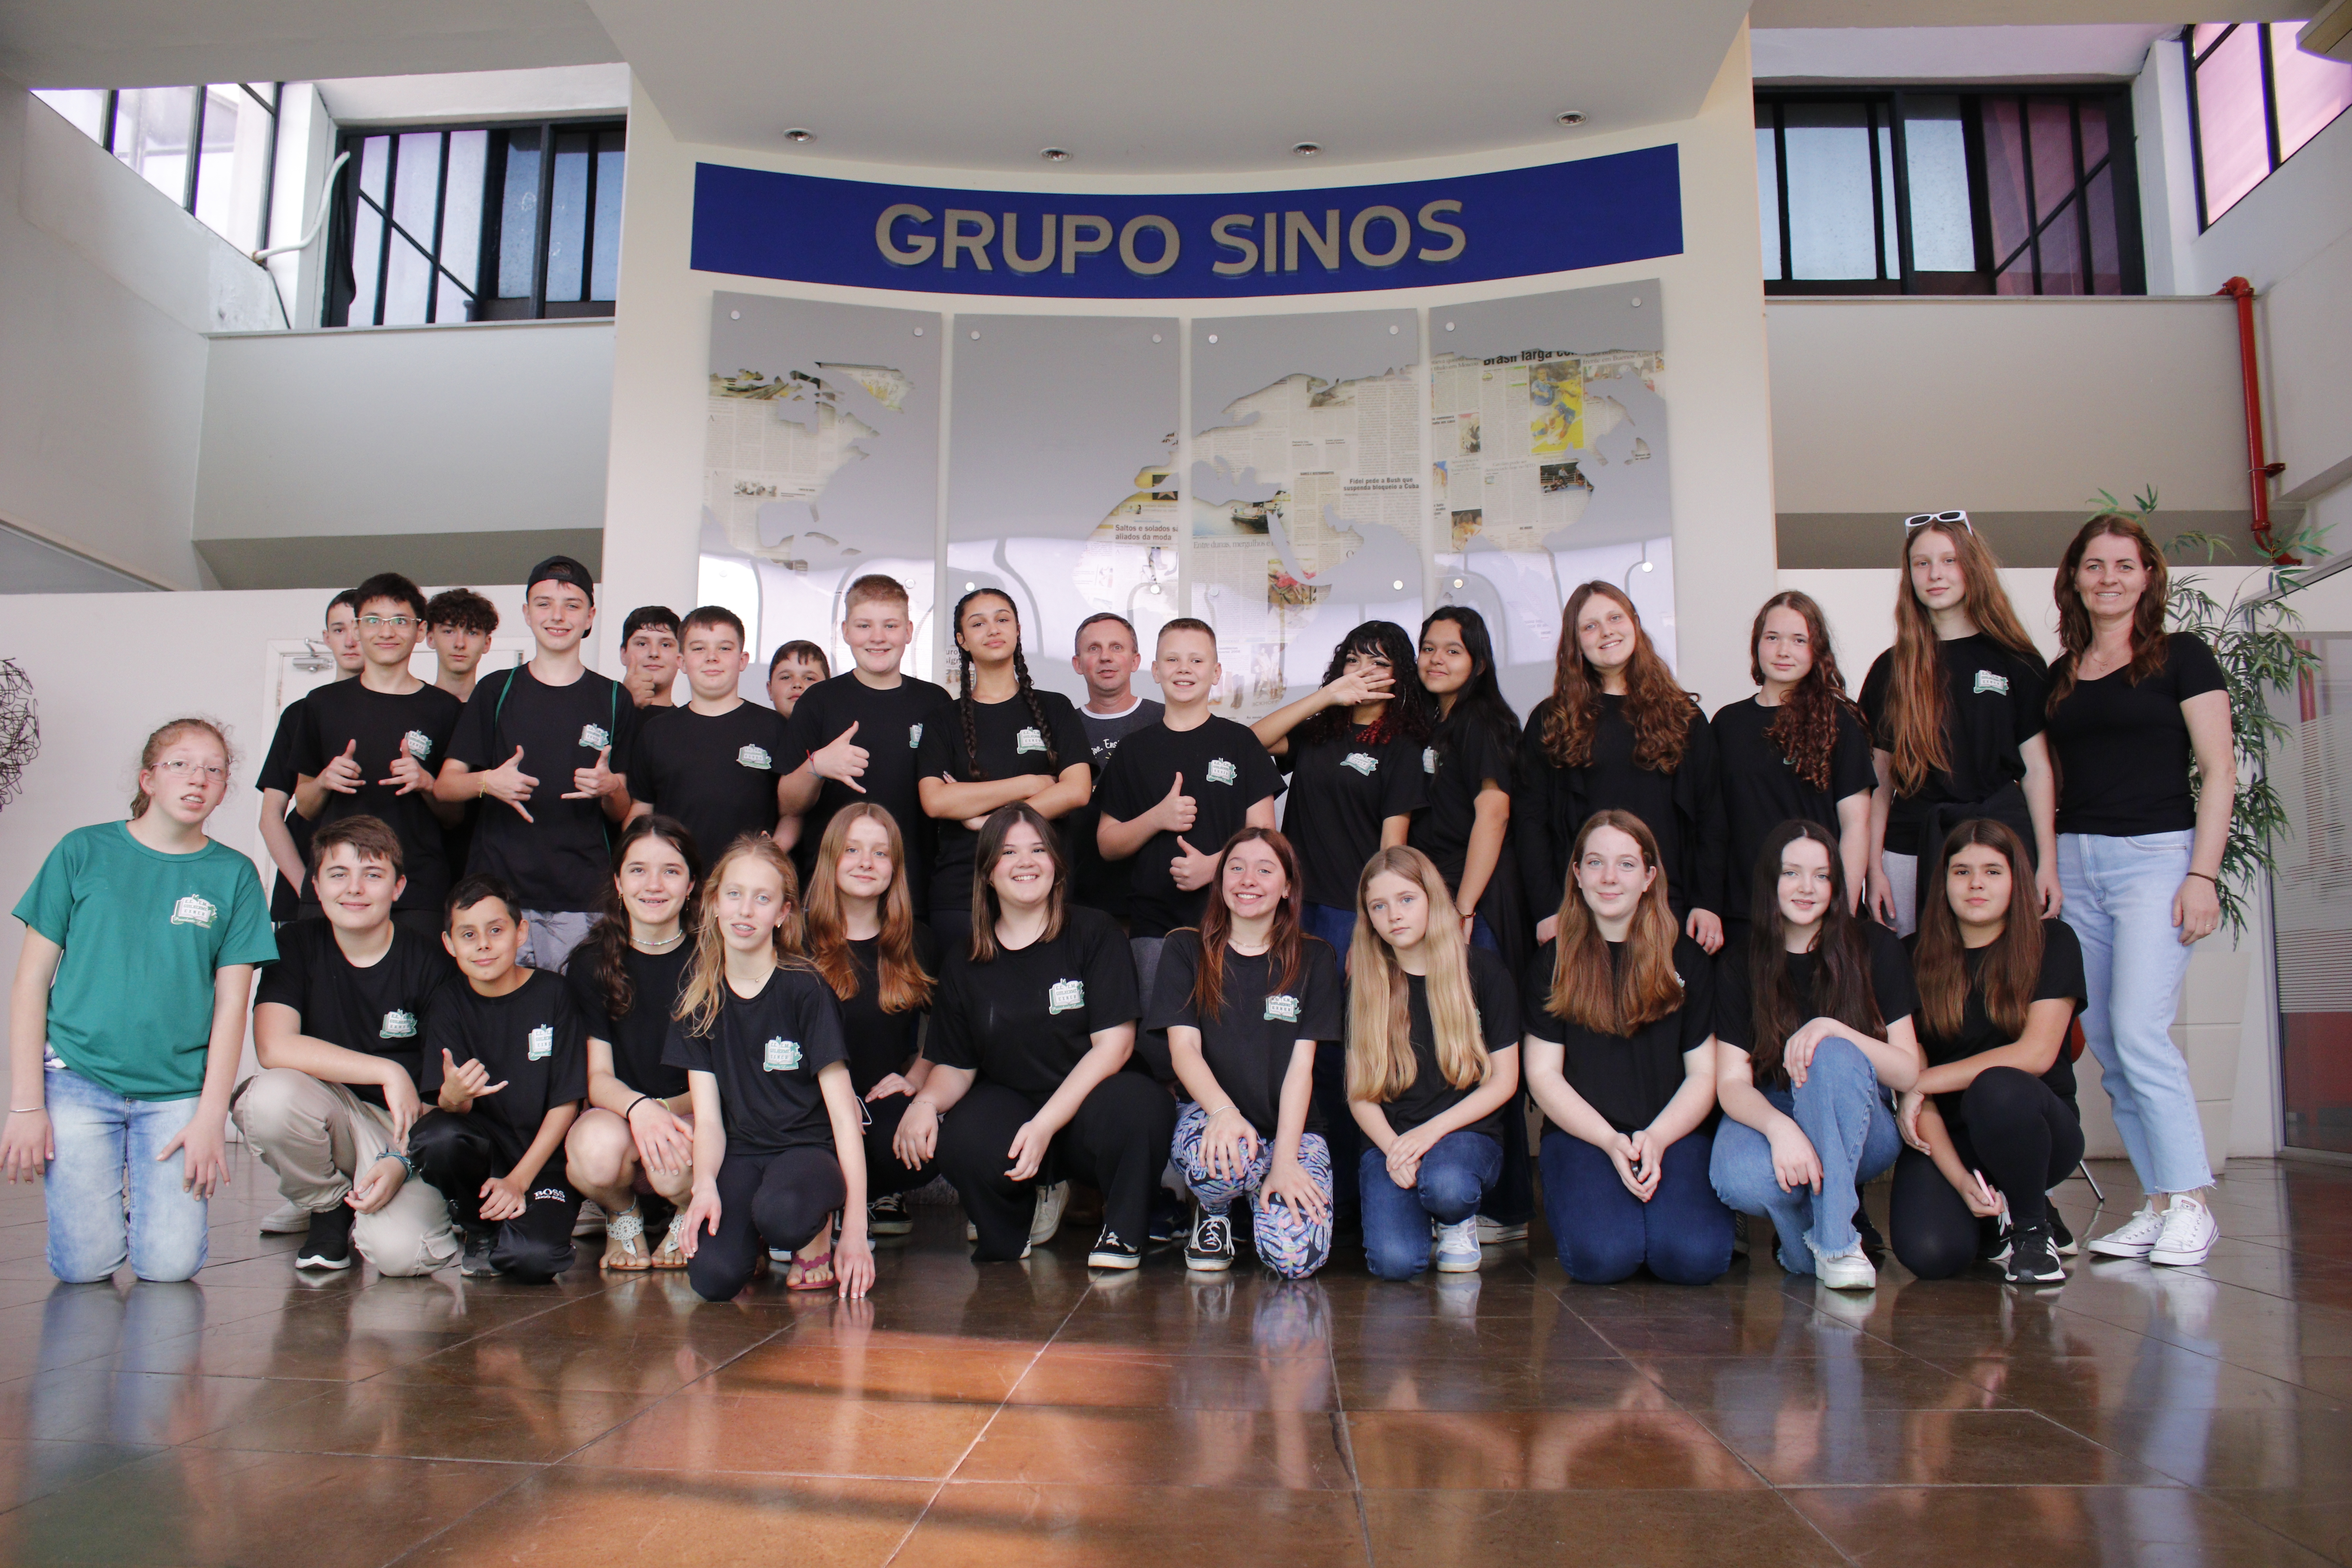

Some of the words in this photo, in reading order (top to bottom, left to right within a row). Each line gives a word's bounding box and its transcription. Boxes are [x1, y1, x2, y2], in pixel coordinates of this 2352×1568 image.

[875, 203, 1180, 275] GRUPO
[1211, 199, 1466, 275] SINOS
[1521, 350, 1552, 361] larga
[1210, 541, 1231, 549] dunas,
[1232, 539, 1265, 549] mergulhos
[1103, 739, 1120, 749] Ens
[534, 1188, 565, 1198] BOSS
